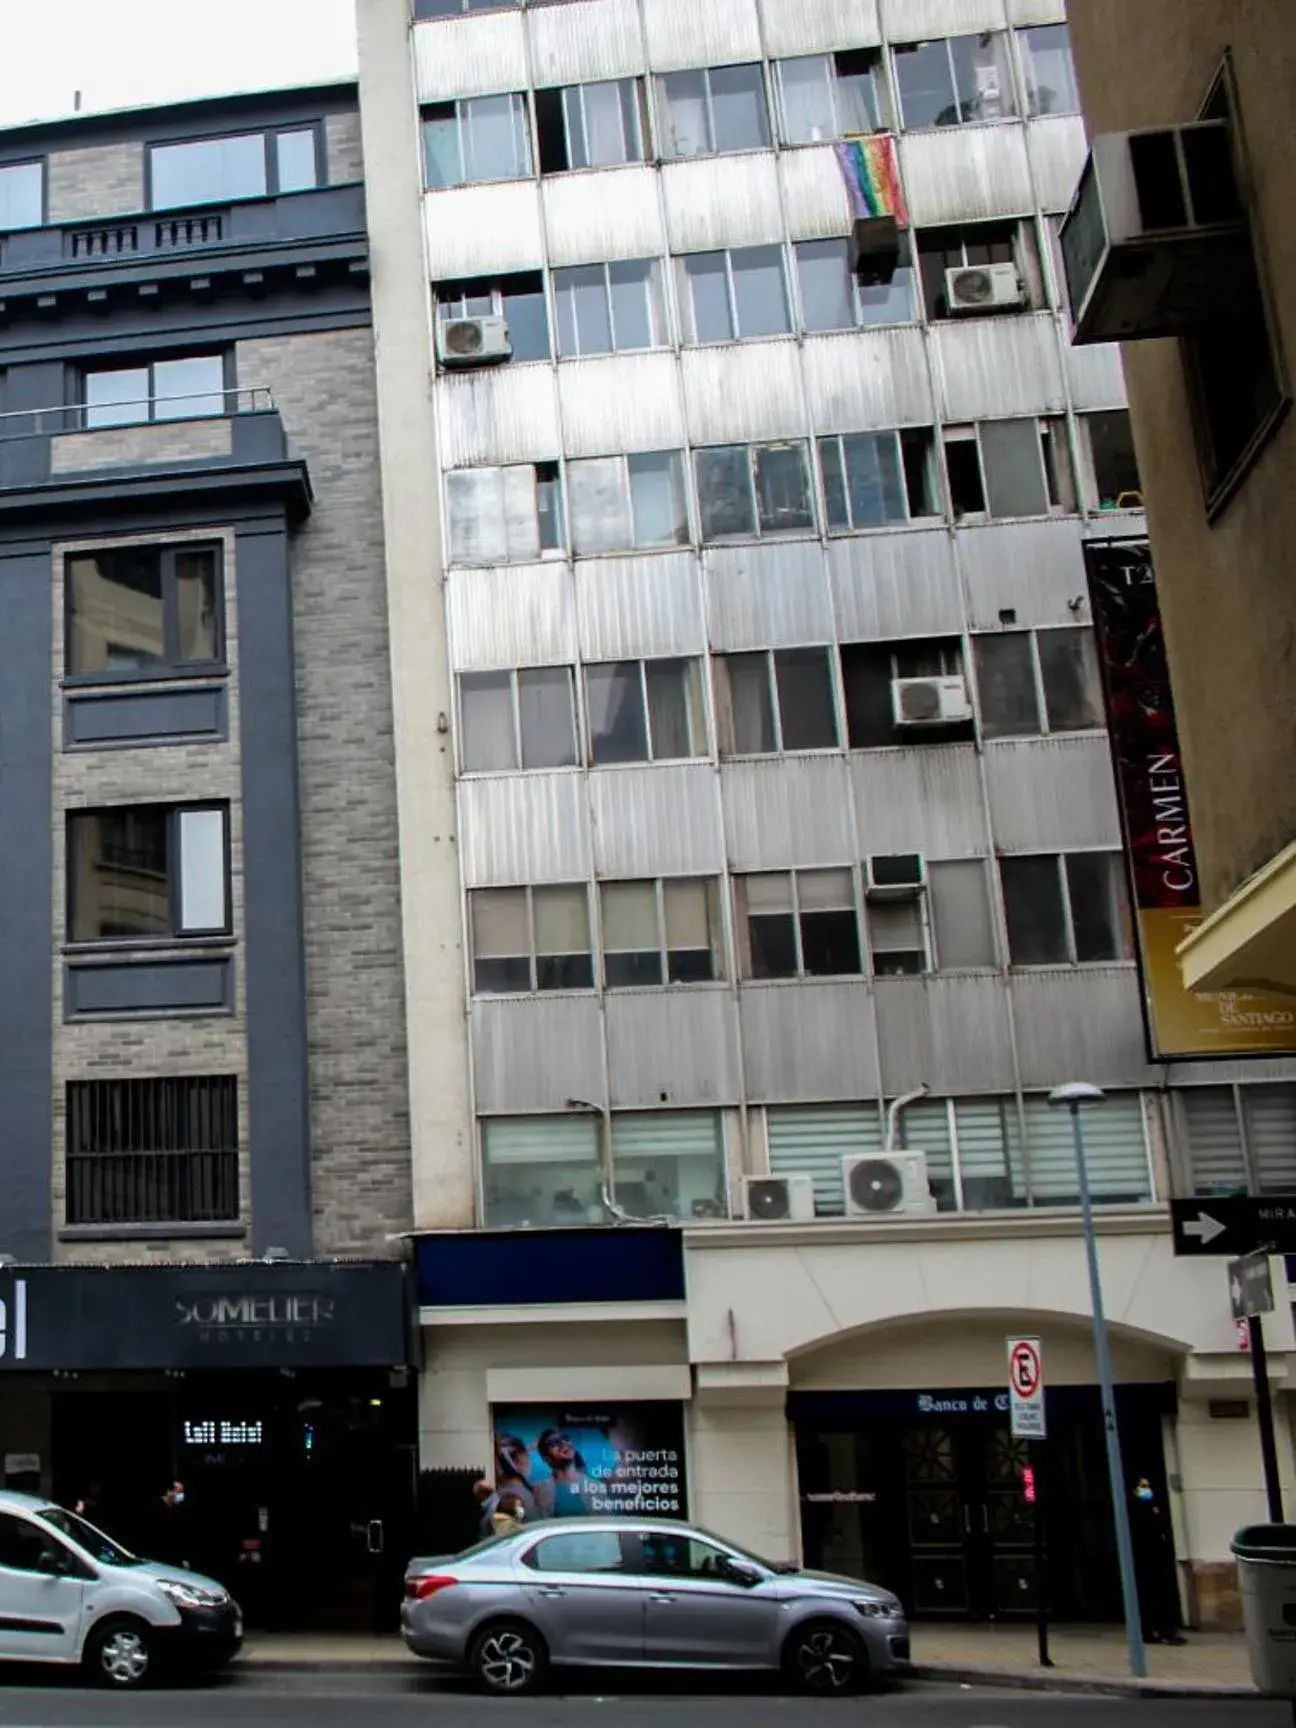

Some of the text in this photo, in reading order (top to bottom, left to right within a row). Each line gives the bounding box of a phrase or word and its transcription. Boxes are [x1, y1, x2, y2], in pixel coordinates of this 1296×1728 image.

[1147, 754, 1194, 891] CARMEN
[175, 1297, 335, 1325] SOMELIER
[918, 1394, 968, 1412] Banco
[972, 1395, 988, 1411] de
[624, 1449, 679, 1465] puerta
[592, 1465, 679, 1478] de entrada
[570, 1480, 679, 1498] a los mejores
[592, 1494, 680, 1511] beneficios
